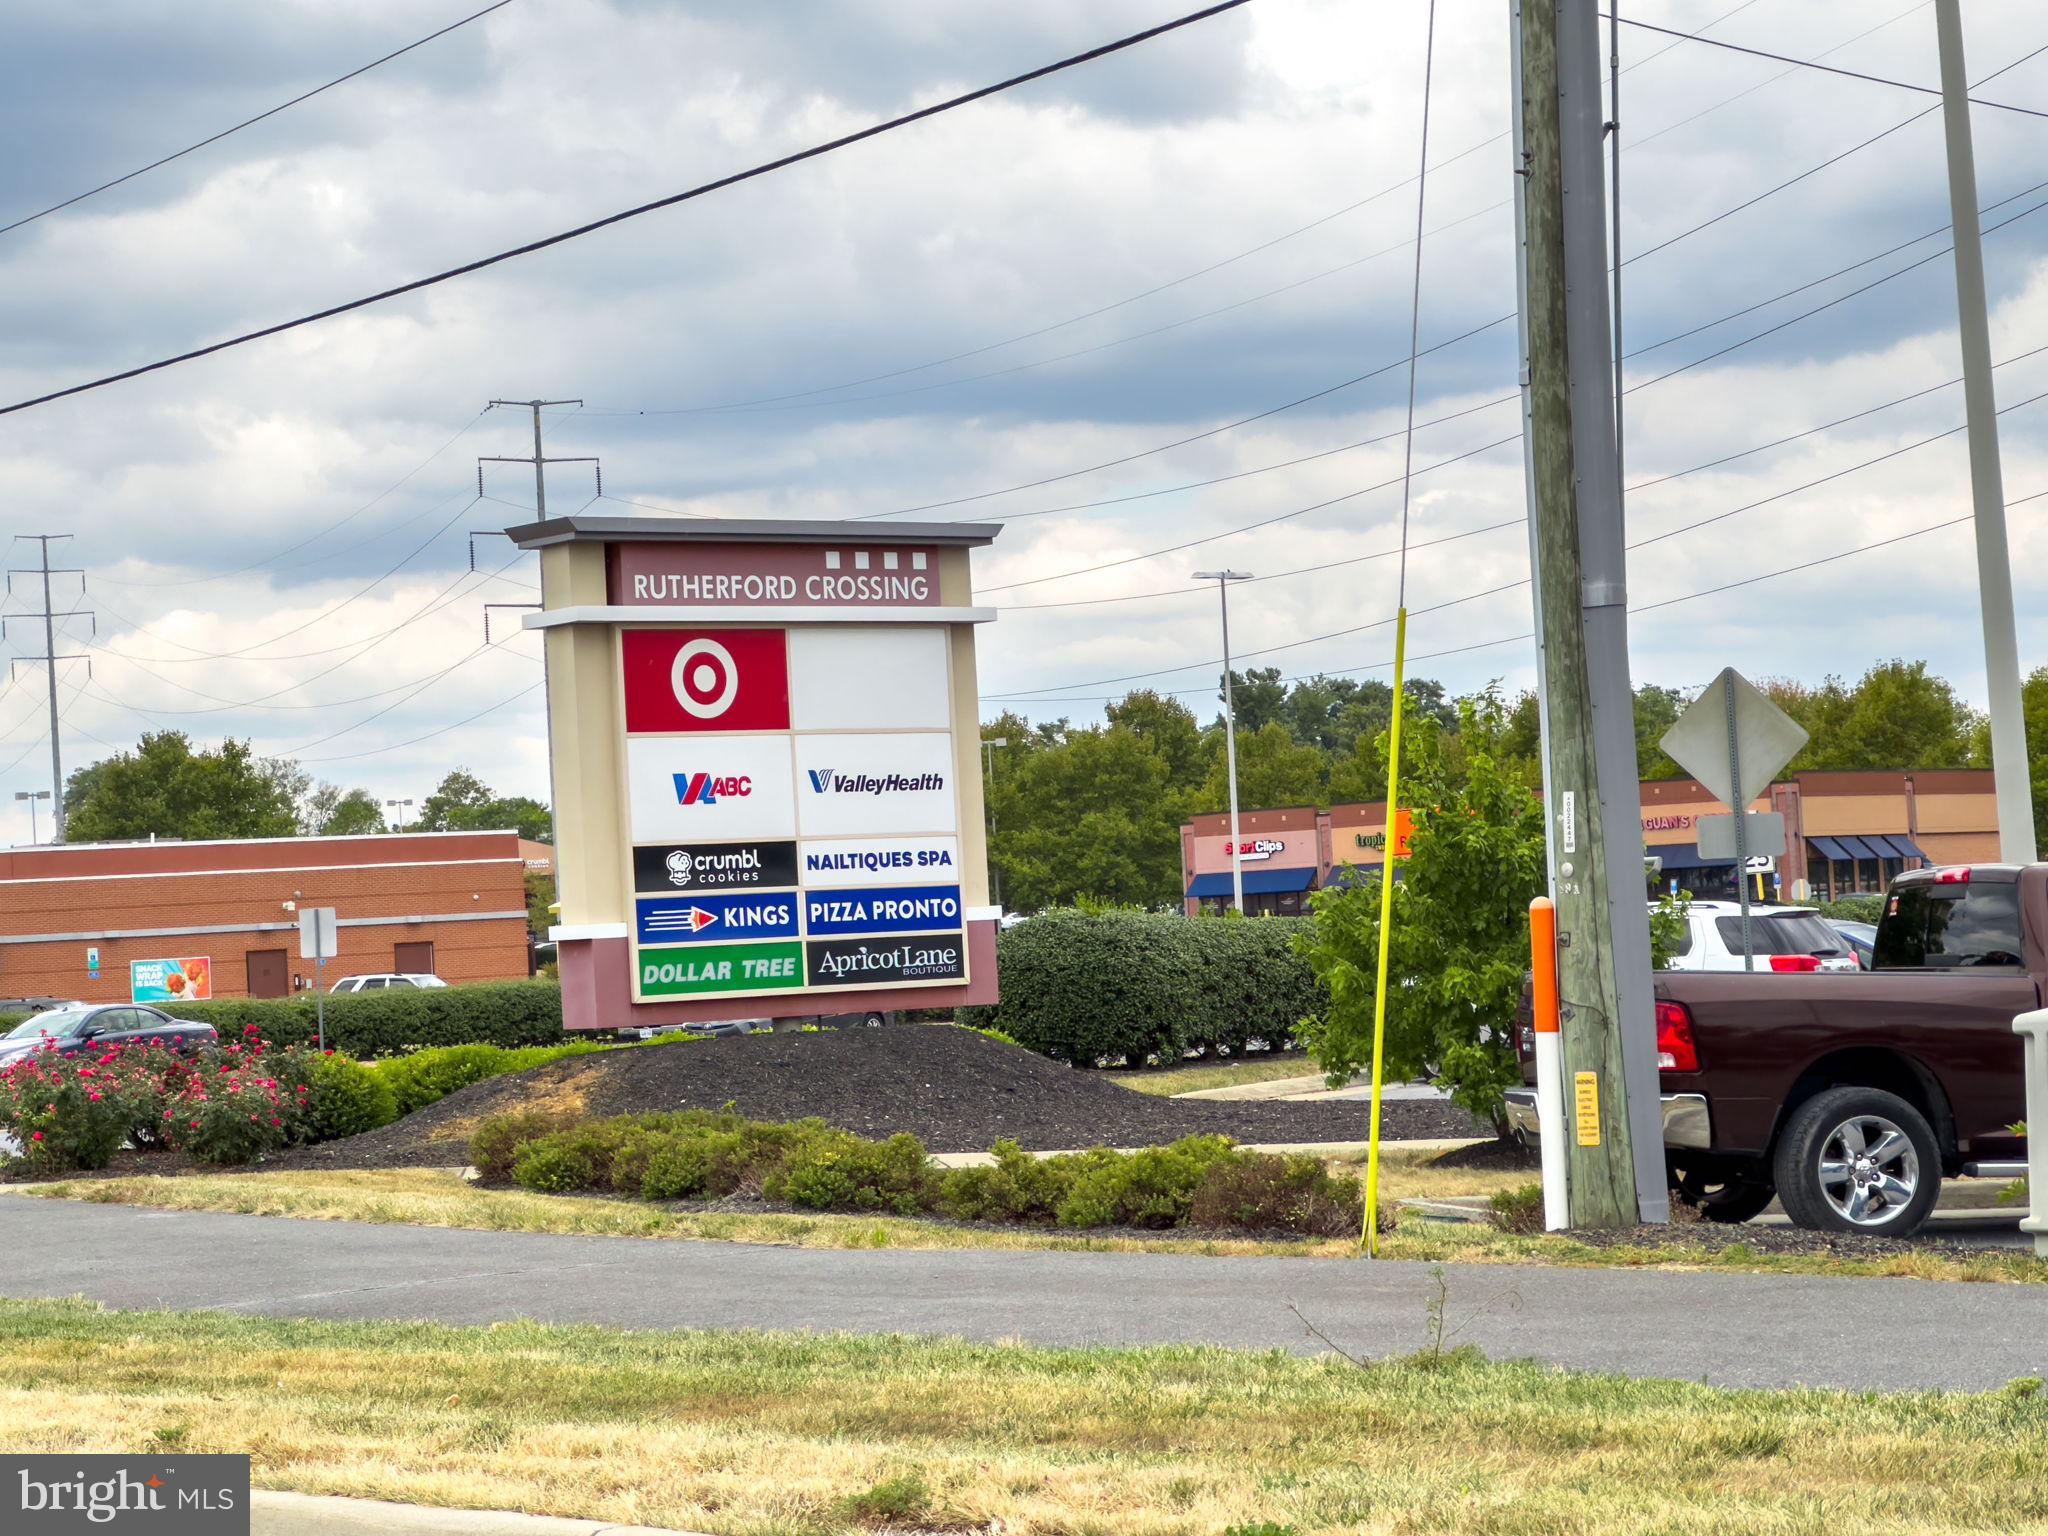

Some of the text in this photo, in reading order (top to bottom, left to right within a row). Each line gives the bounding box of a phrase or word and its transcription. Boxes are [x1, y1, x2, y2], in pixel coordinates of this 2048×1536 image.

[633, 574, 929, 601] RUTHERFORD CROSSING
[708, 776, 752, 797] ABC
[694, 848, 762, 872] crumbl
[807, 850, 953, 872] NAILTIQUES SPA
[699, 871, 759, 884] cookies
[724, 904, 790, 928] KINGS
[811, 897, 957, 923] PIZZA PRONTO
[135, 972, 164, 981] WRAP
[643, 957, 796, 985] DOLLAR TREE
[902, 964, 958, 976] BOUTIQUE
